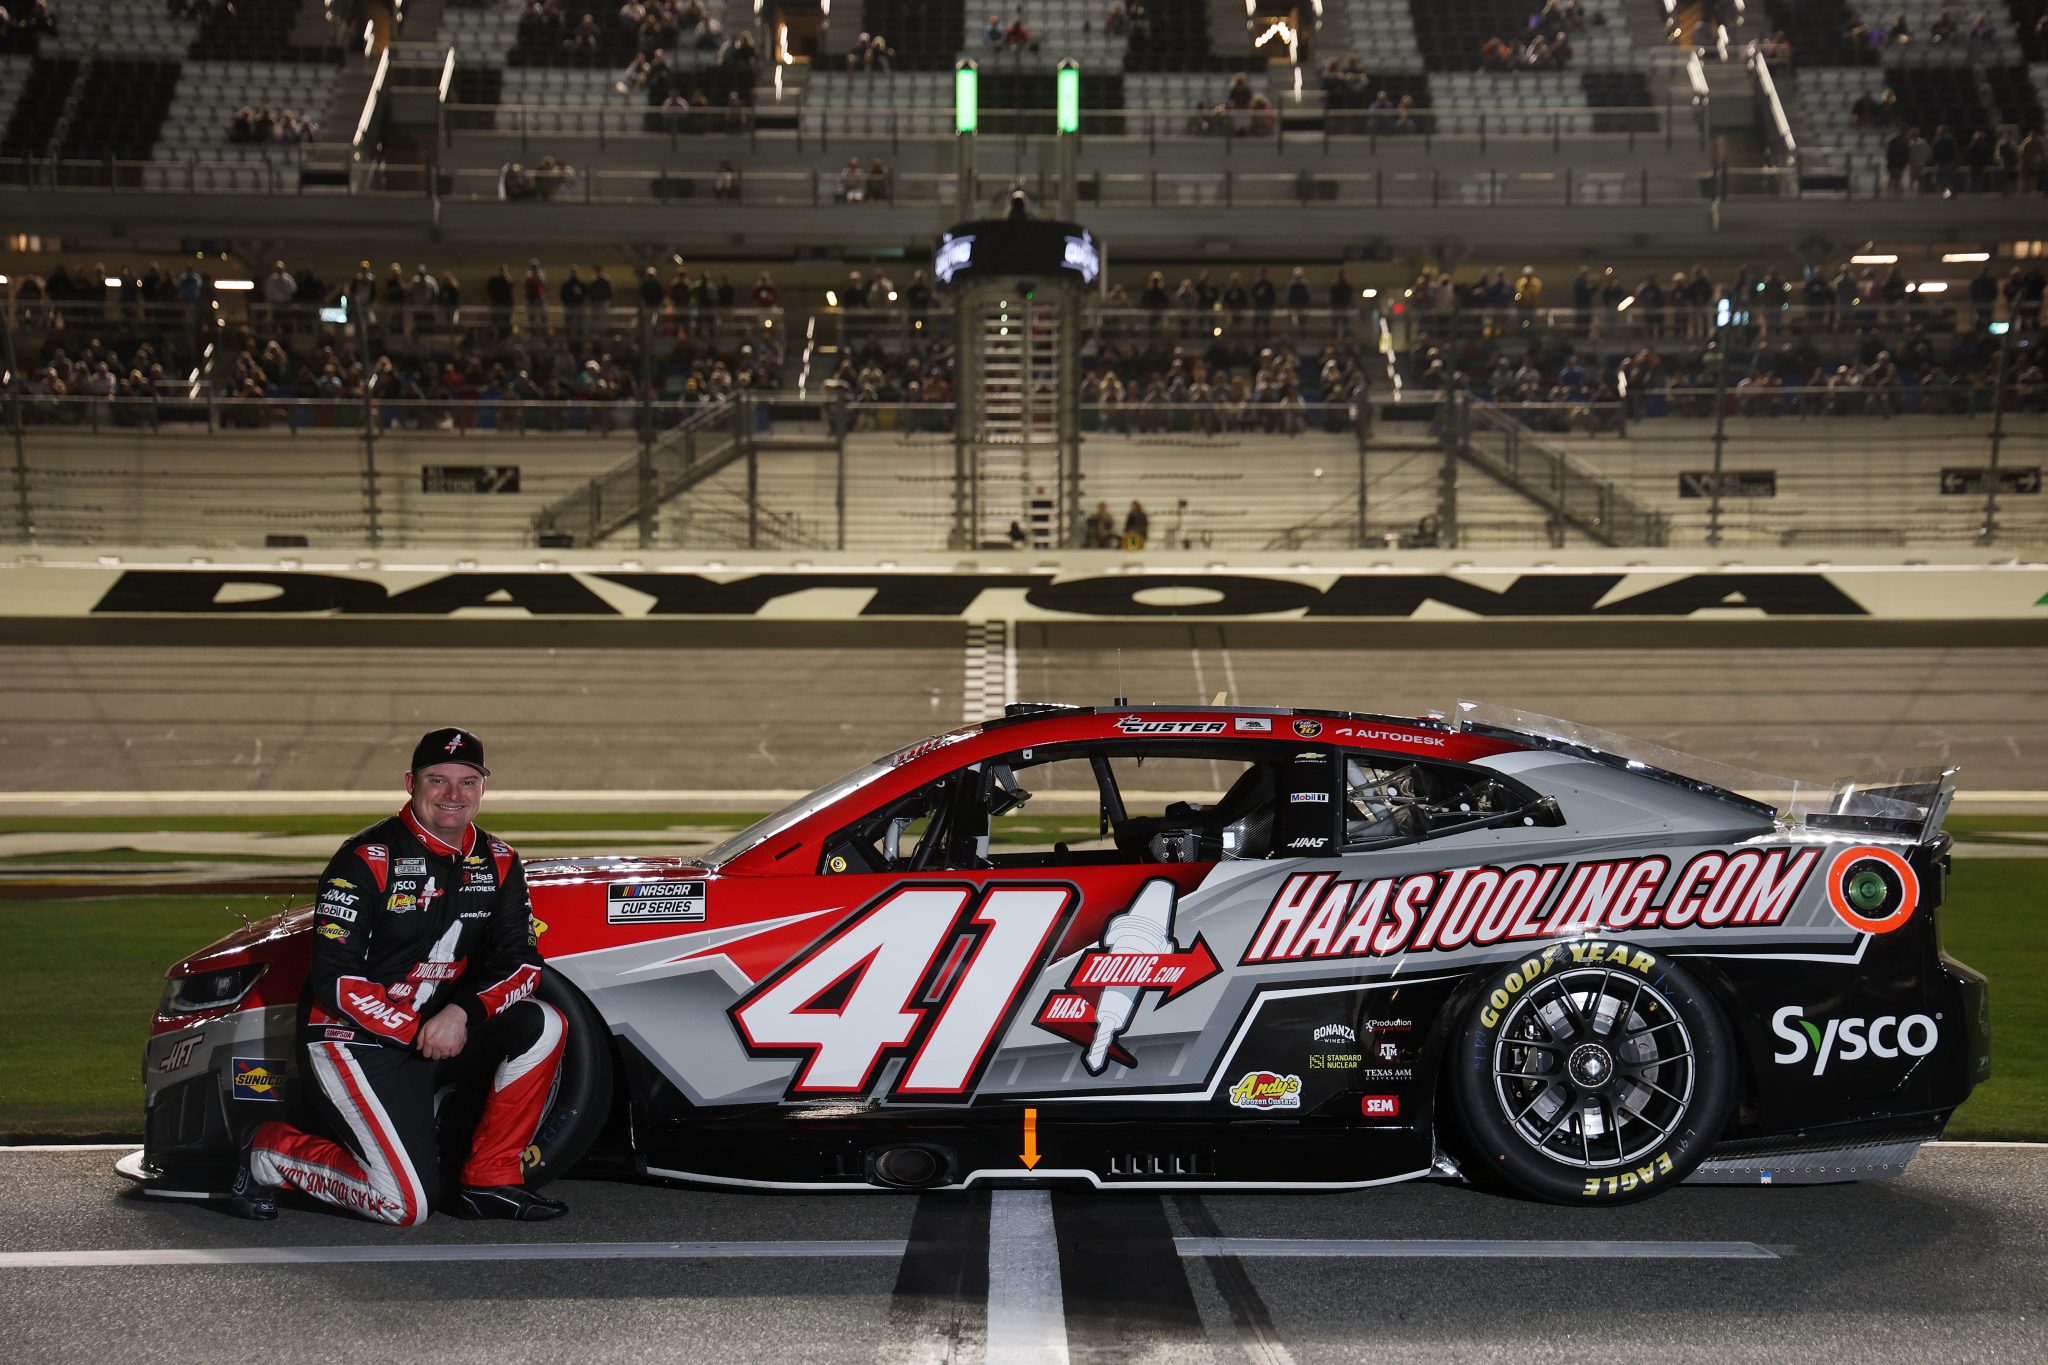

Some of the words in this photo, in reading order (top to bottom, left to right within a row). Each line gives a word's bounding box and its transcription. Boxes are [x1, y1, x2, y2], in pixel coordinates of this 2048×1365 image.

[91, 571, 1871, 615] DAYTONA
[1119, 717, 1226, 733] CUSTER
[1356, 729, 1445, 747] AUTODESK
[1292, 794, 1316, 802] Mobil
[1287, 838, 1329, 848] HAAS
[322, 889, 360, 905] HAAS
[639, 885, 691, 896] NASCAR
[621, 902, 647, 914] CUP
[648, 901, 692, 913] SERIES
[1246, 847, 1822, 962] HAASTOOLING.COM
[317, 926, 350, 938] SUNOCO
[388, 983, 413, 997] HAAS
[734, 886, 1073, 1094] 41
[348, 992, 413, 1028] HAAS
[1047, 998, 1089, 1019] HAAS
[326, 1029, 352, 1039] SIMPSON
[1313, 1024, 1355, 1042] BONANZA
[161, 1034, 205, 1072] HFT
[1233, 1075, 1299, 1103] Andy's
[1240, 1097, 1267, 1105] Frozen
[1268, 1097, 1298, 1105] Custard
[1367, 1100, 1394, 1112] SEM
[1583, 1152, 1673, 1195] EAGLE
